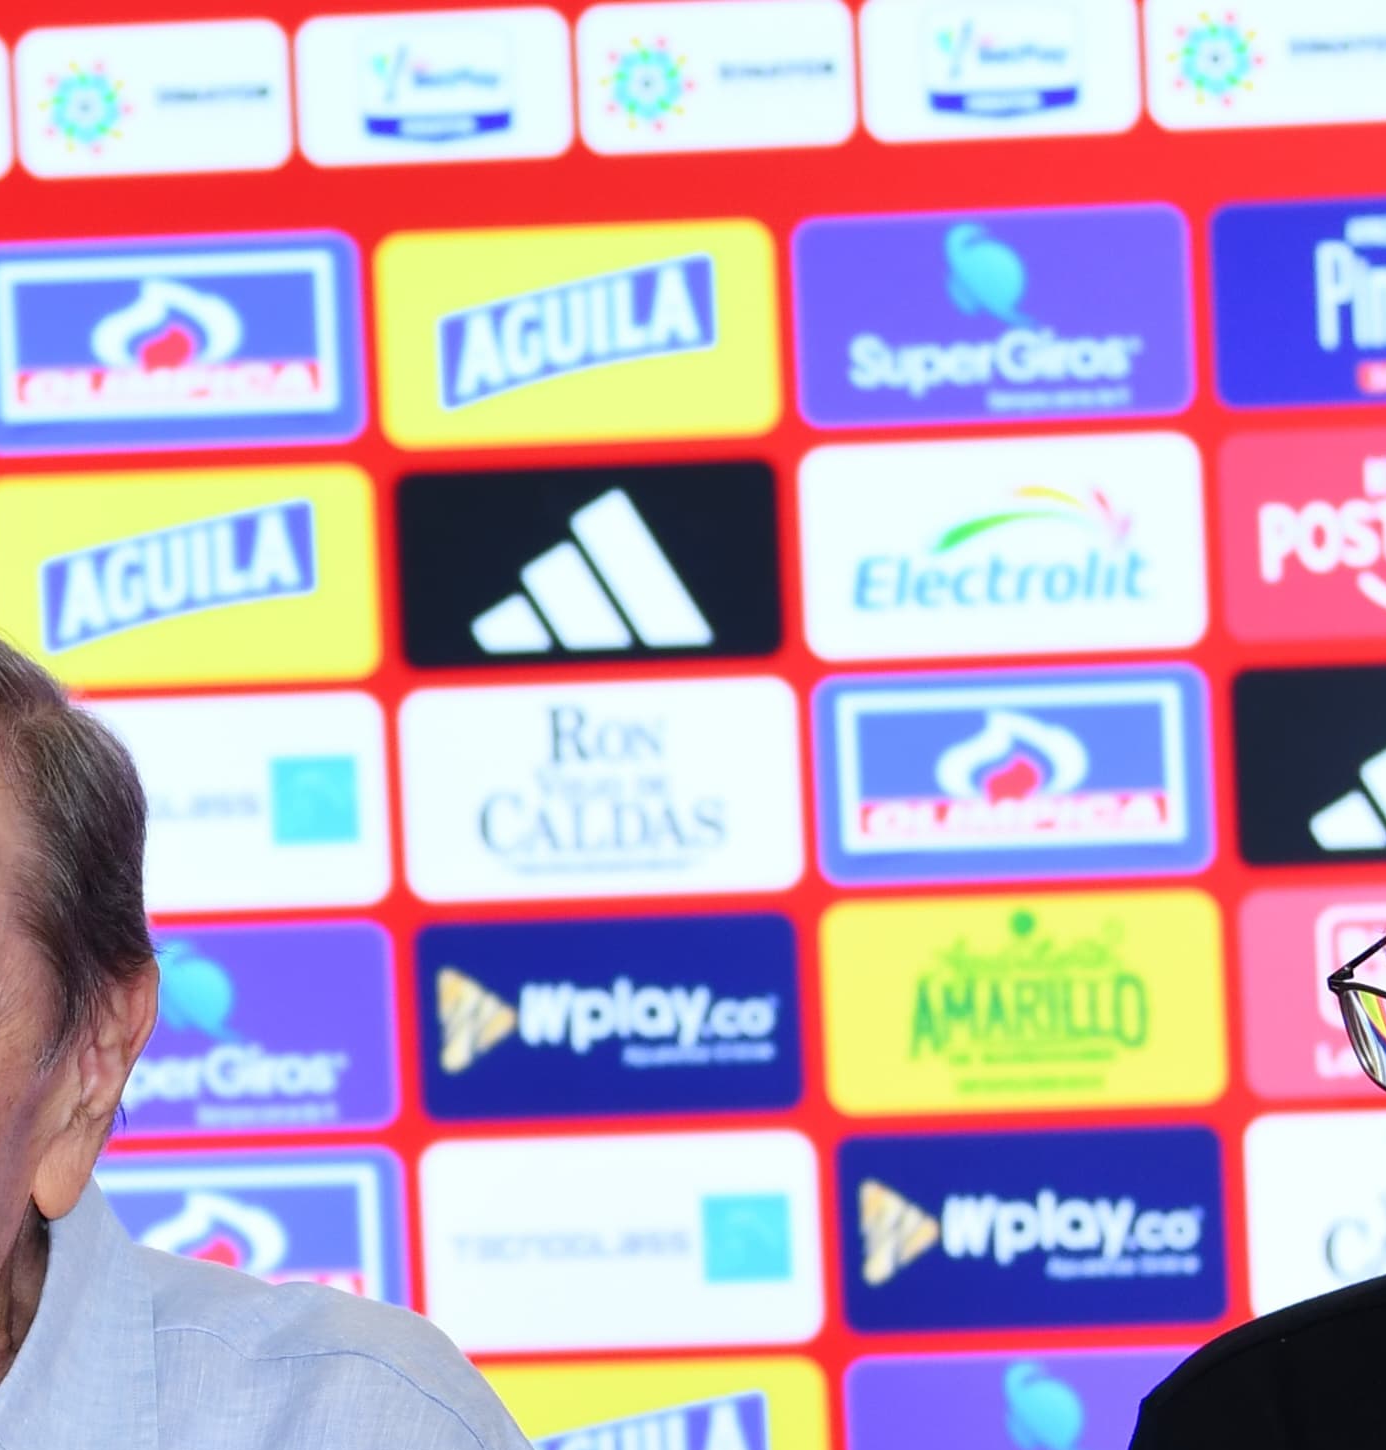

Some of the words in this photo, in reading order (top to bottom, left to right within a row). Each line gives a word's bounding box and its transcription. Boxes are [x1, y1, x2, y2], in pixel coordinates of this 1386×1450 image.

[454, 263, 703, 400] AGUILA
[848, 330, 1132, 398] SuperGiros
[58, 503, 303, 641] AGUILA
[853, 552, 1149, 612] Electrolit
[519, 977, 776, 1054] Wplay.co
[910, 972, 1148, 1058] AMARILLO
[942, 1189, 1199, 1265] Wplay.co
